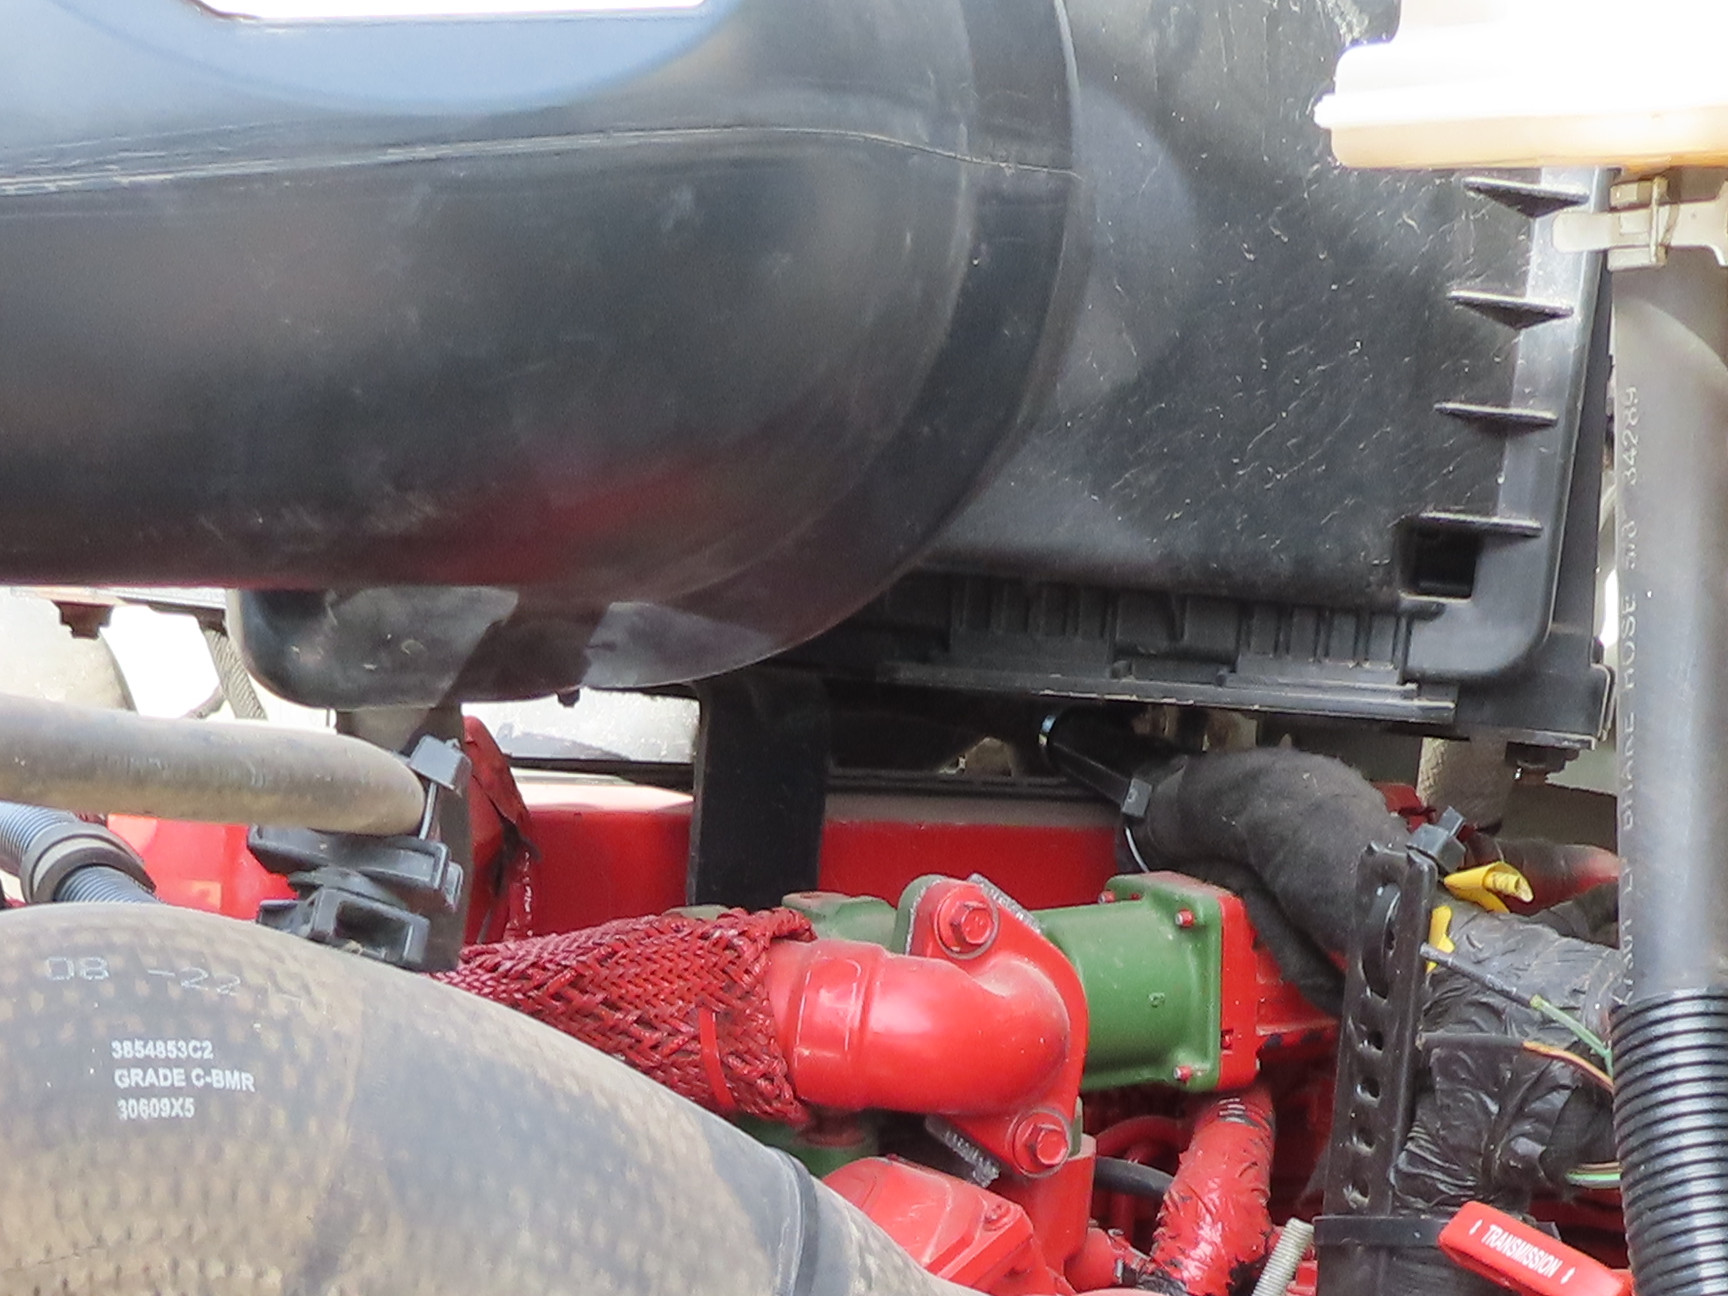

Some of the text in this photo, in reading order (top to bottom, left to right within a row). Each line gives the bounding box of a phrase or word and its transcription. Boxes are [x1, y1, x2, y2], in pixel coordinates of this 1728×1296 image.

[110, 1038, 214, 1060] 3854853C2
[113, 1067, 256, 1093] GRADE C-BMR
[1480, 1224, 1564, 1278] TRANSMISSION
